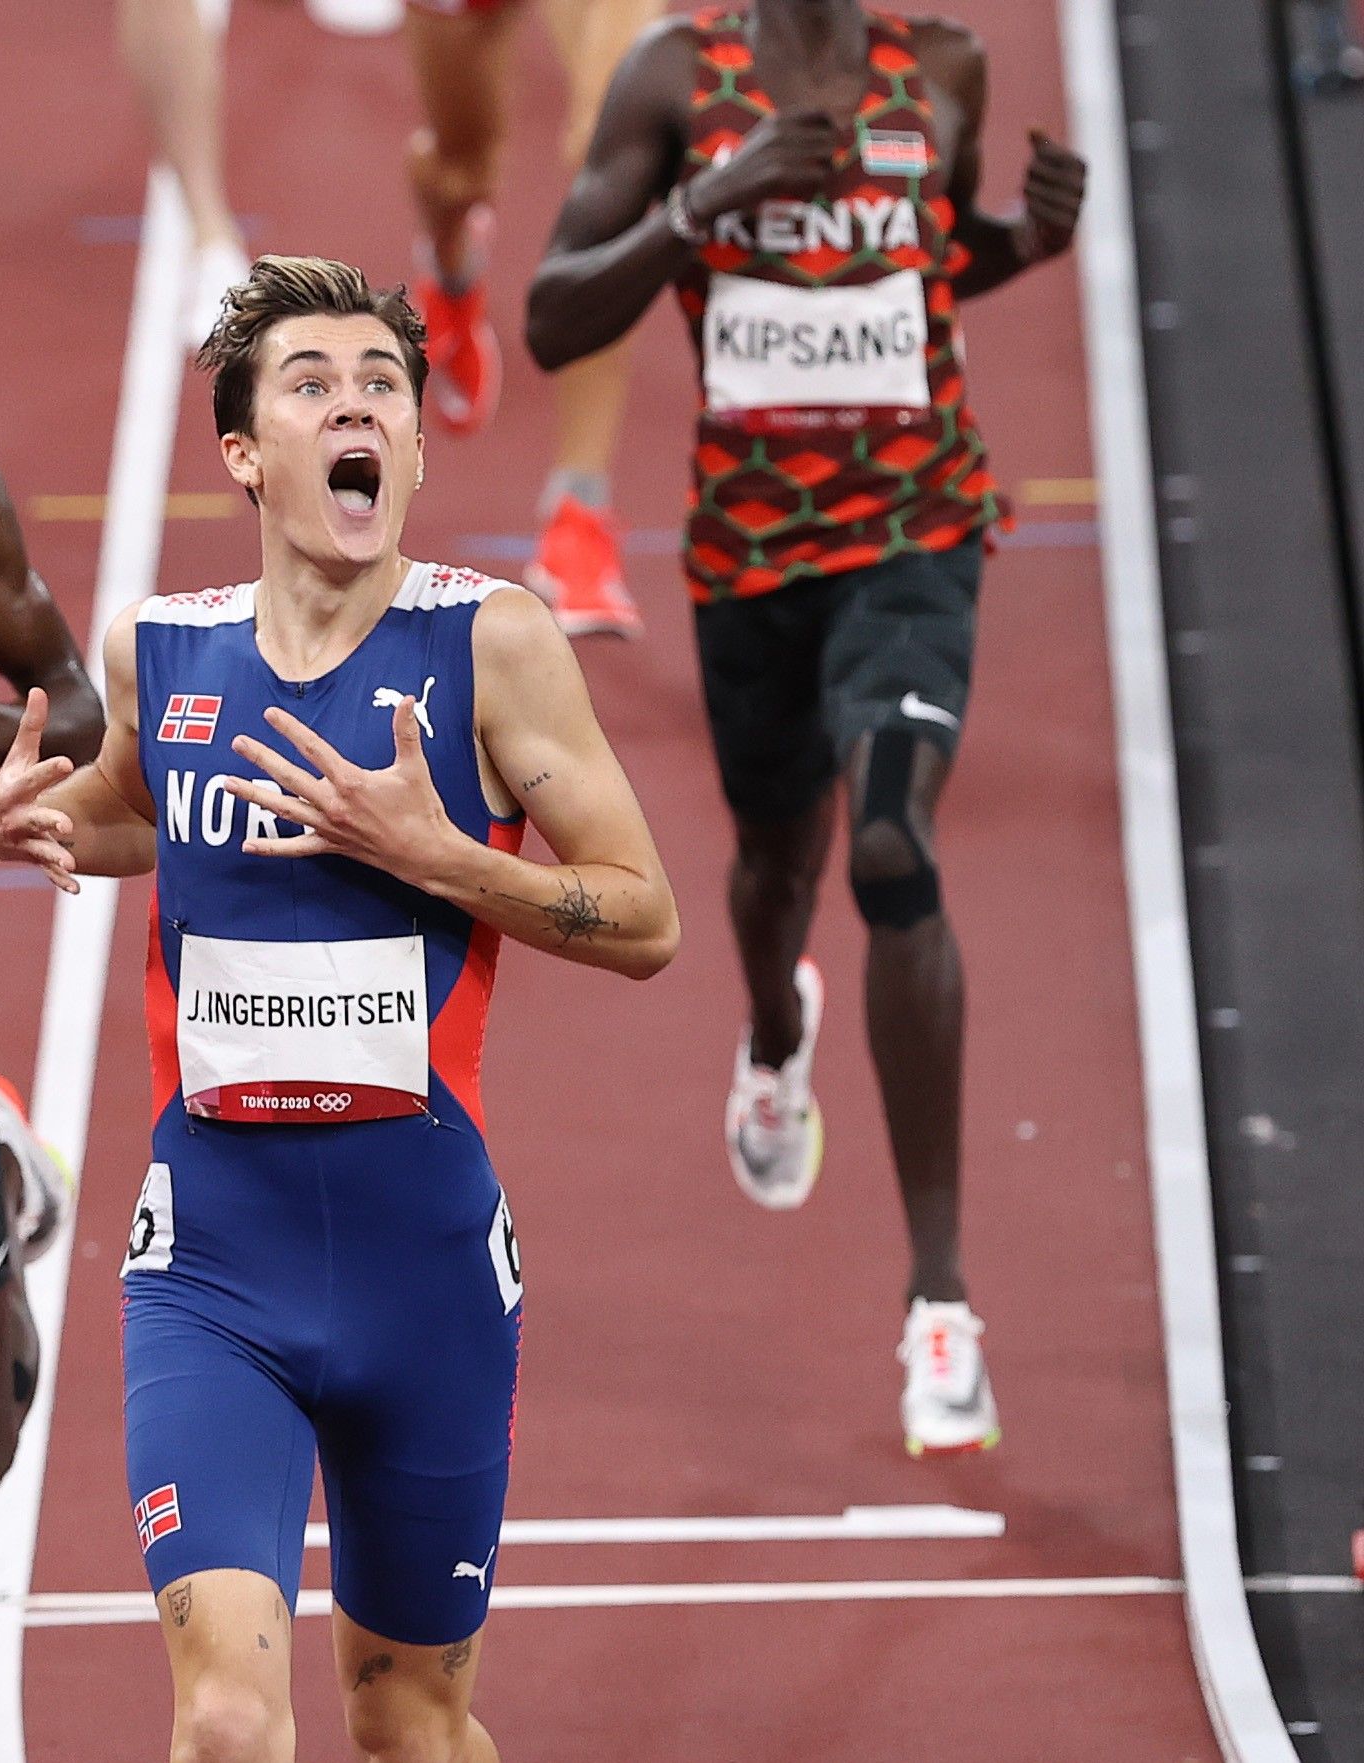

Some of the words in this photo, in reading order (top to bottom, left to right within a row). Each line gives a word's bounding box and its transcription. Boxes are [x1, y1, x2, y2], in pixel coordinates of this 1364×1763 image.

[713, 197, 921, 252] KENYA
[715, 310, 916, 368] KIPSANG
[186, 989, 416, 1028] J.INGEBRIGTSEN
[241, 1094, 279, 1110] TOKYO
[280, 1096, 311, 1110] 2020
